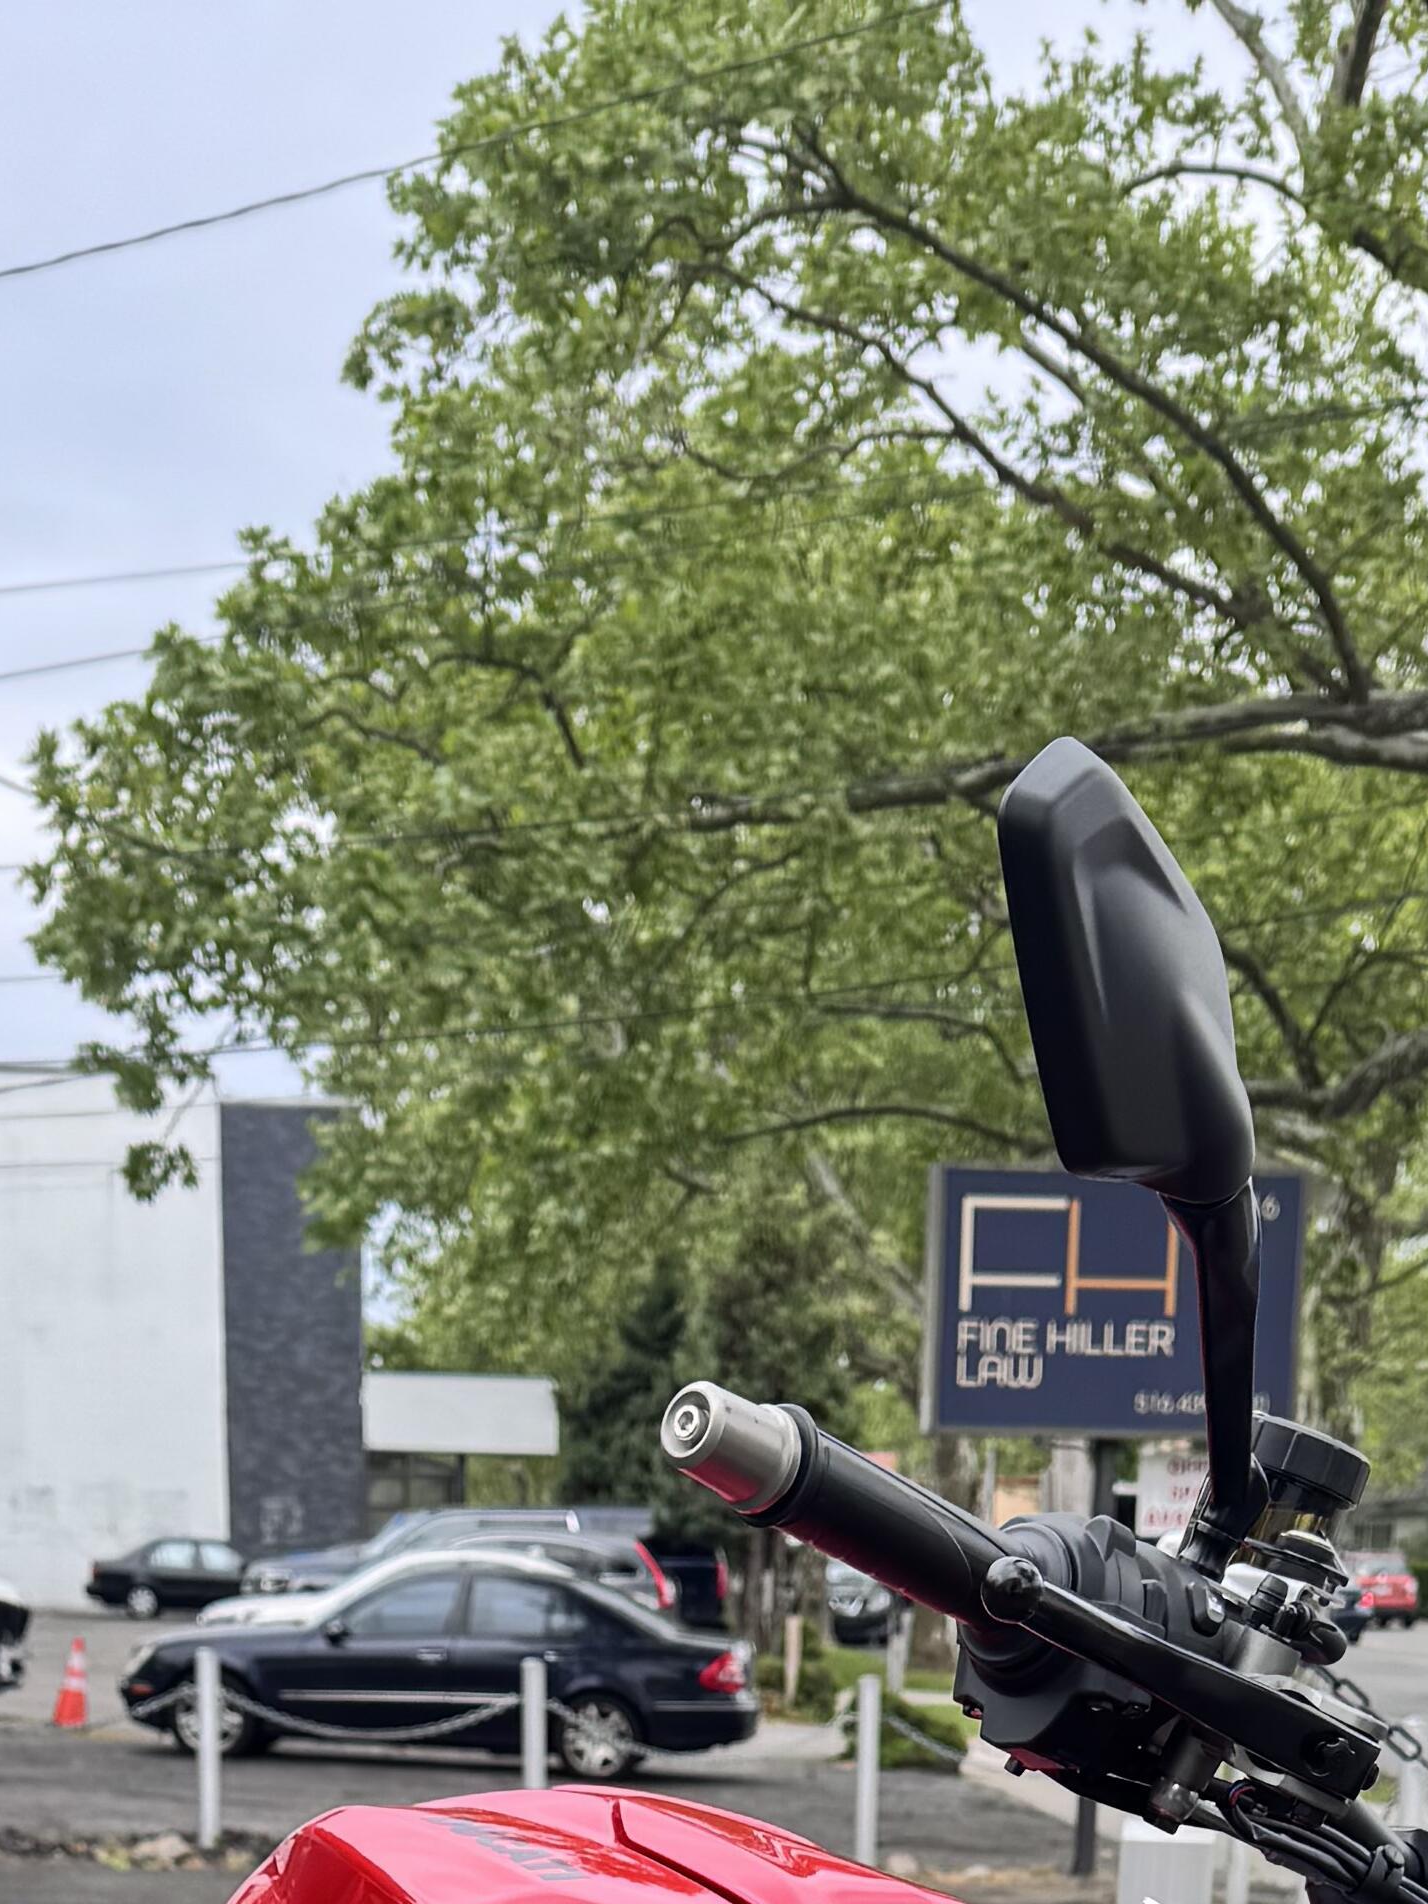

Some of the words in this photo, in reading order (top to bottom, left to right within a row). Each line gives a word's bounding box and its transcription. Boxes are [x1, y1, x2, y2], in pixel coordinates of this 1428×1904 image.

[956, 1319, 1040, 1355] FINE
[1045, 1320, 1176, 1357] HILLER
[956, 1354, 1044, 1389] LAW
